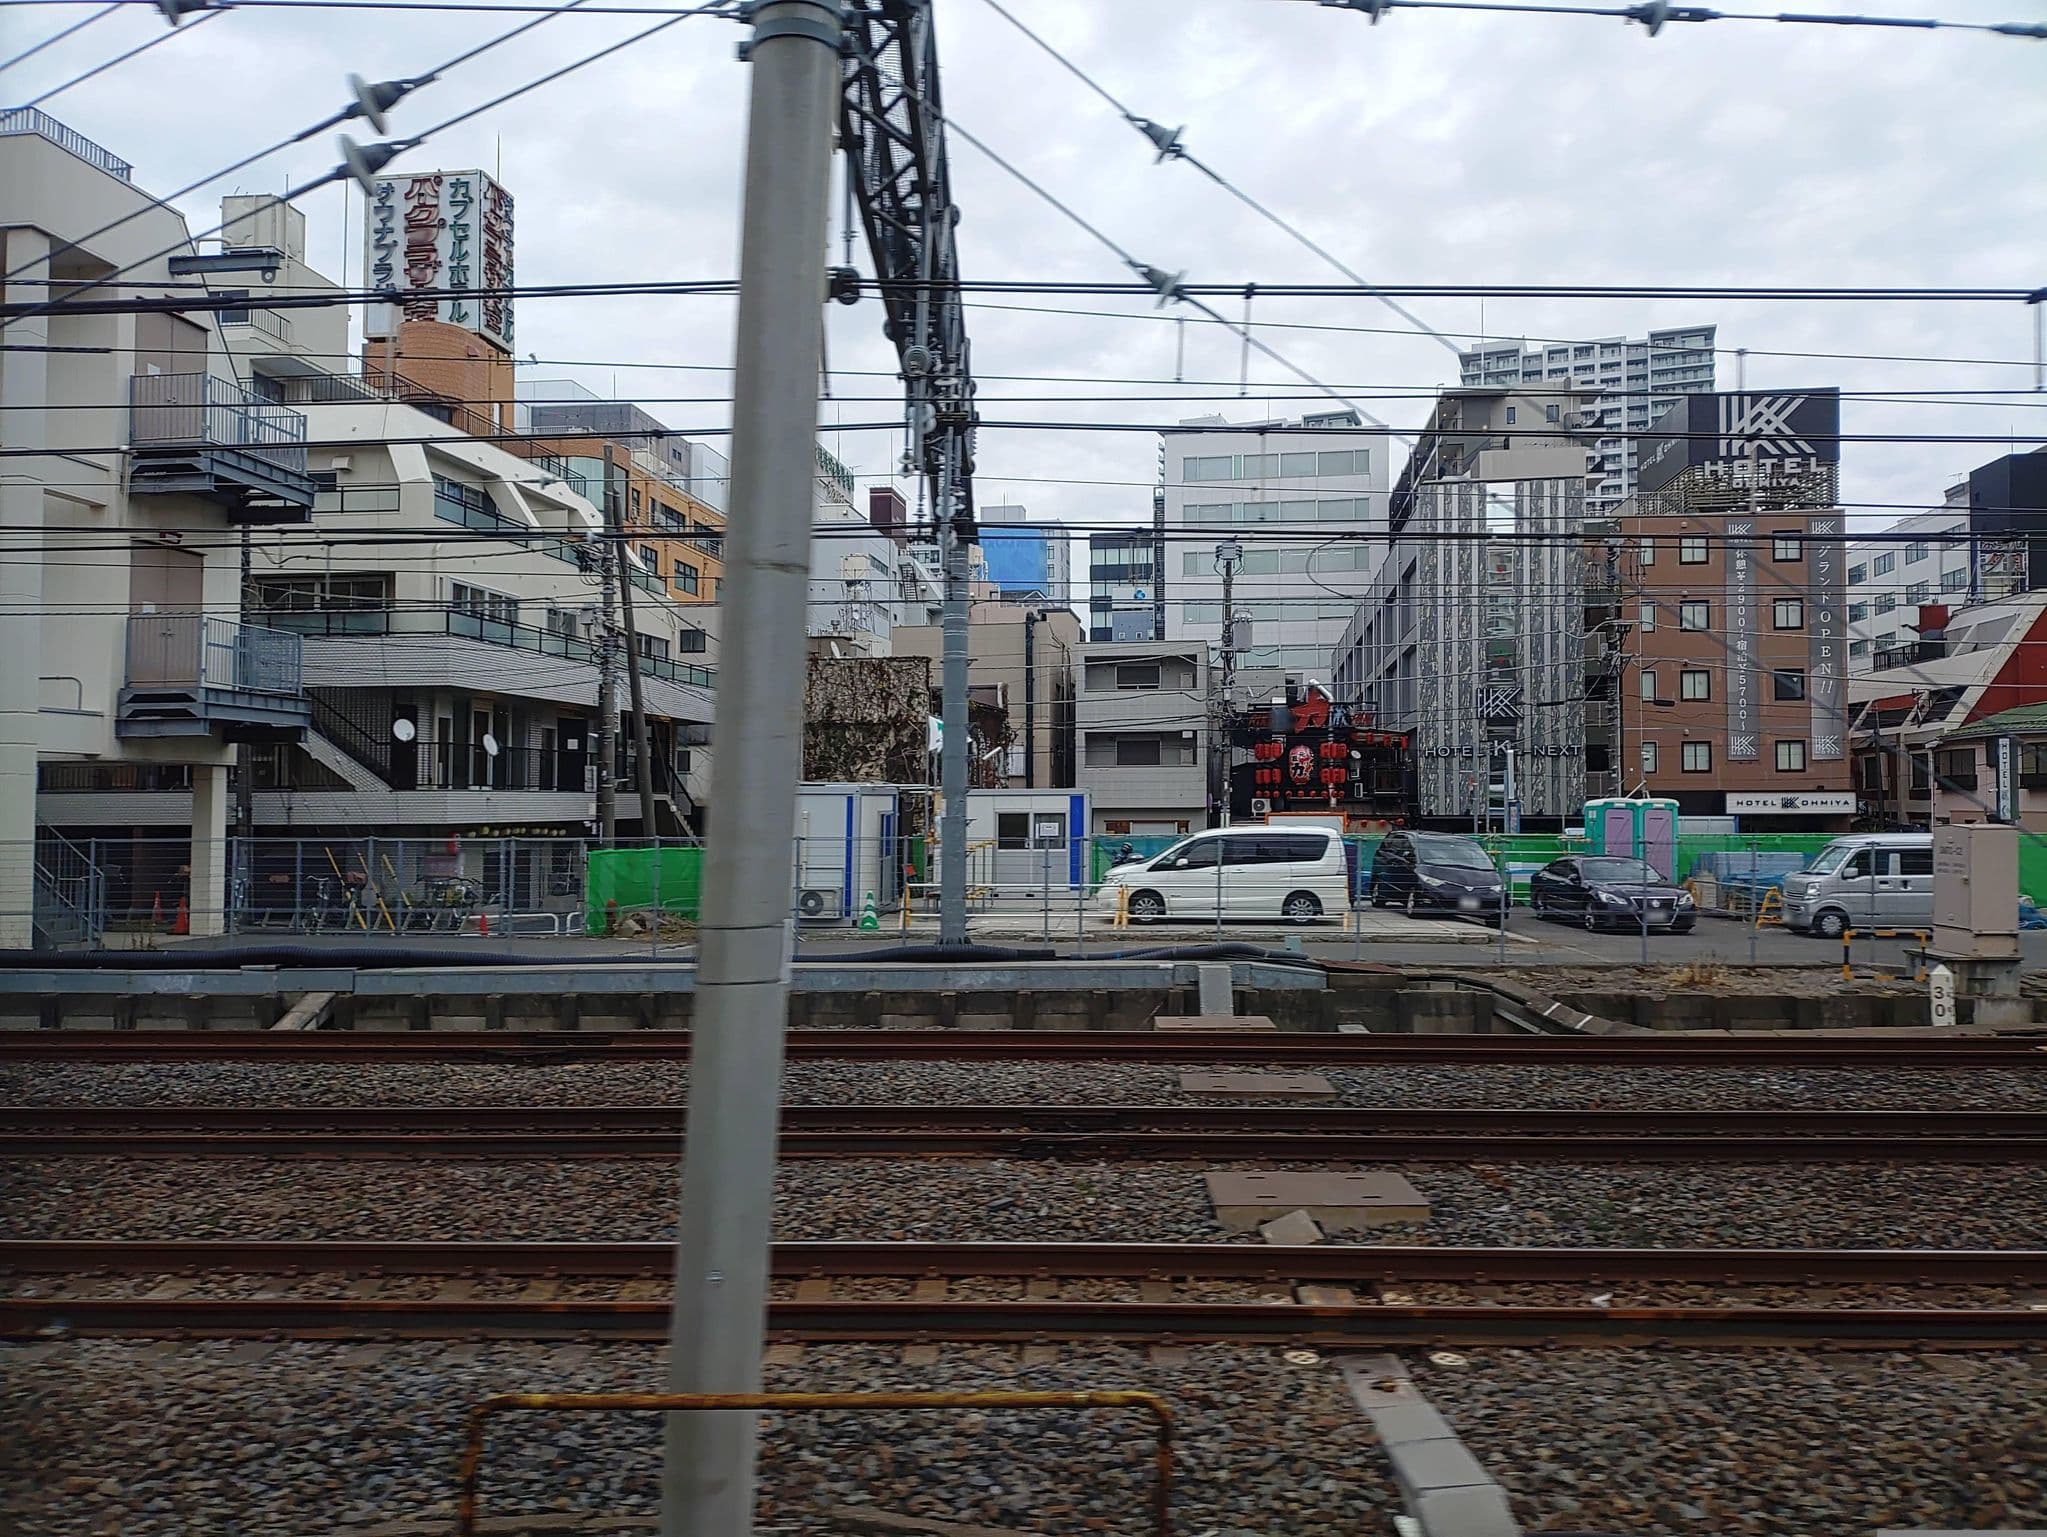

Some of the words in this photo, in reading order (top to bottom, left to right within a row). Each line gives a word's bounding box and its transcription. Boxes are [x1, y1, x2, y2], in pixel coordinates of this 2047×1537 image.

[1703, 456, 1828, 476] HOTEL
[1425, 745, 1484, 757] HOTE
[1534, 745, 1581, 756] NEXT
[2001, 743, 2009, 788] HOTEL
[1934, 986, 1946, 1017] 30
